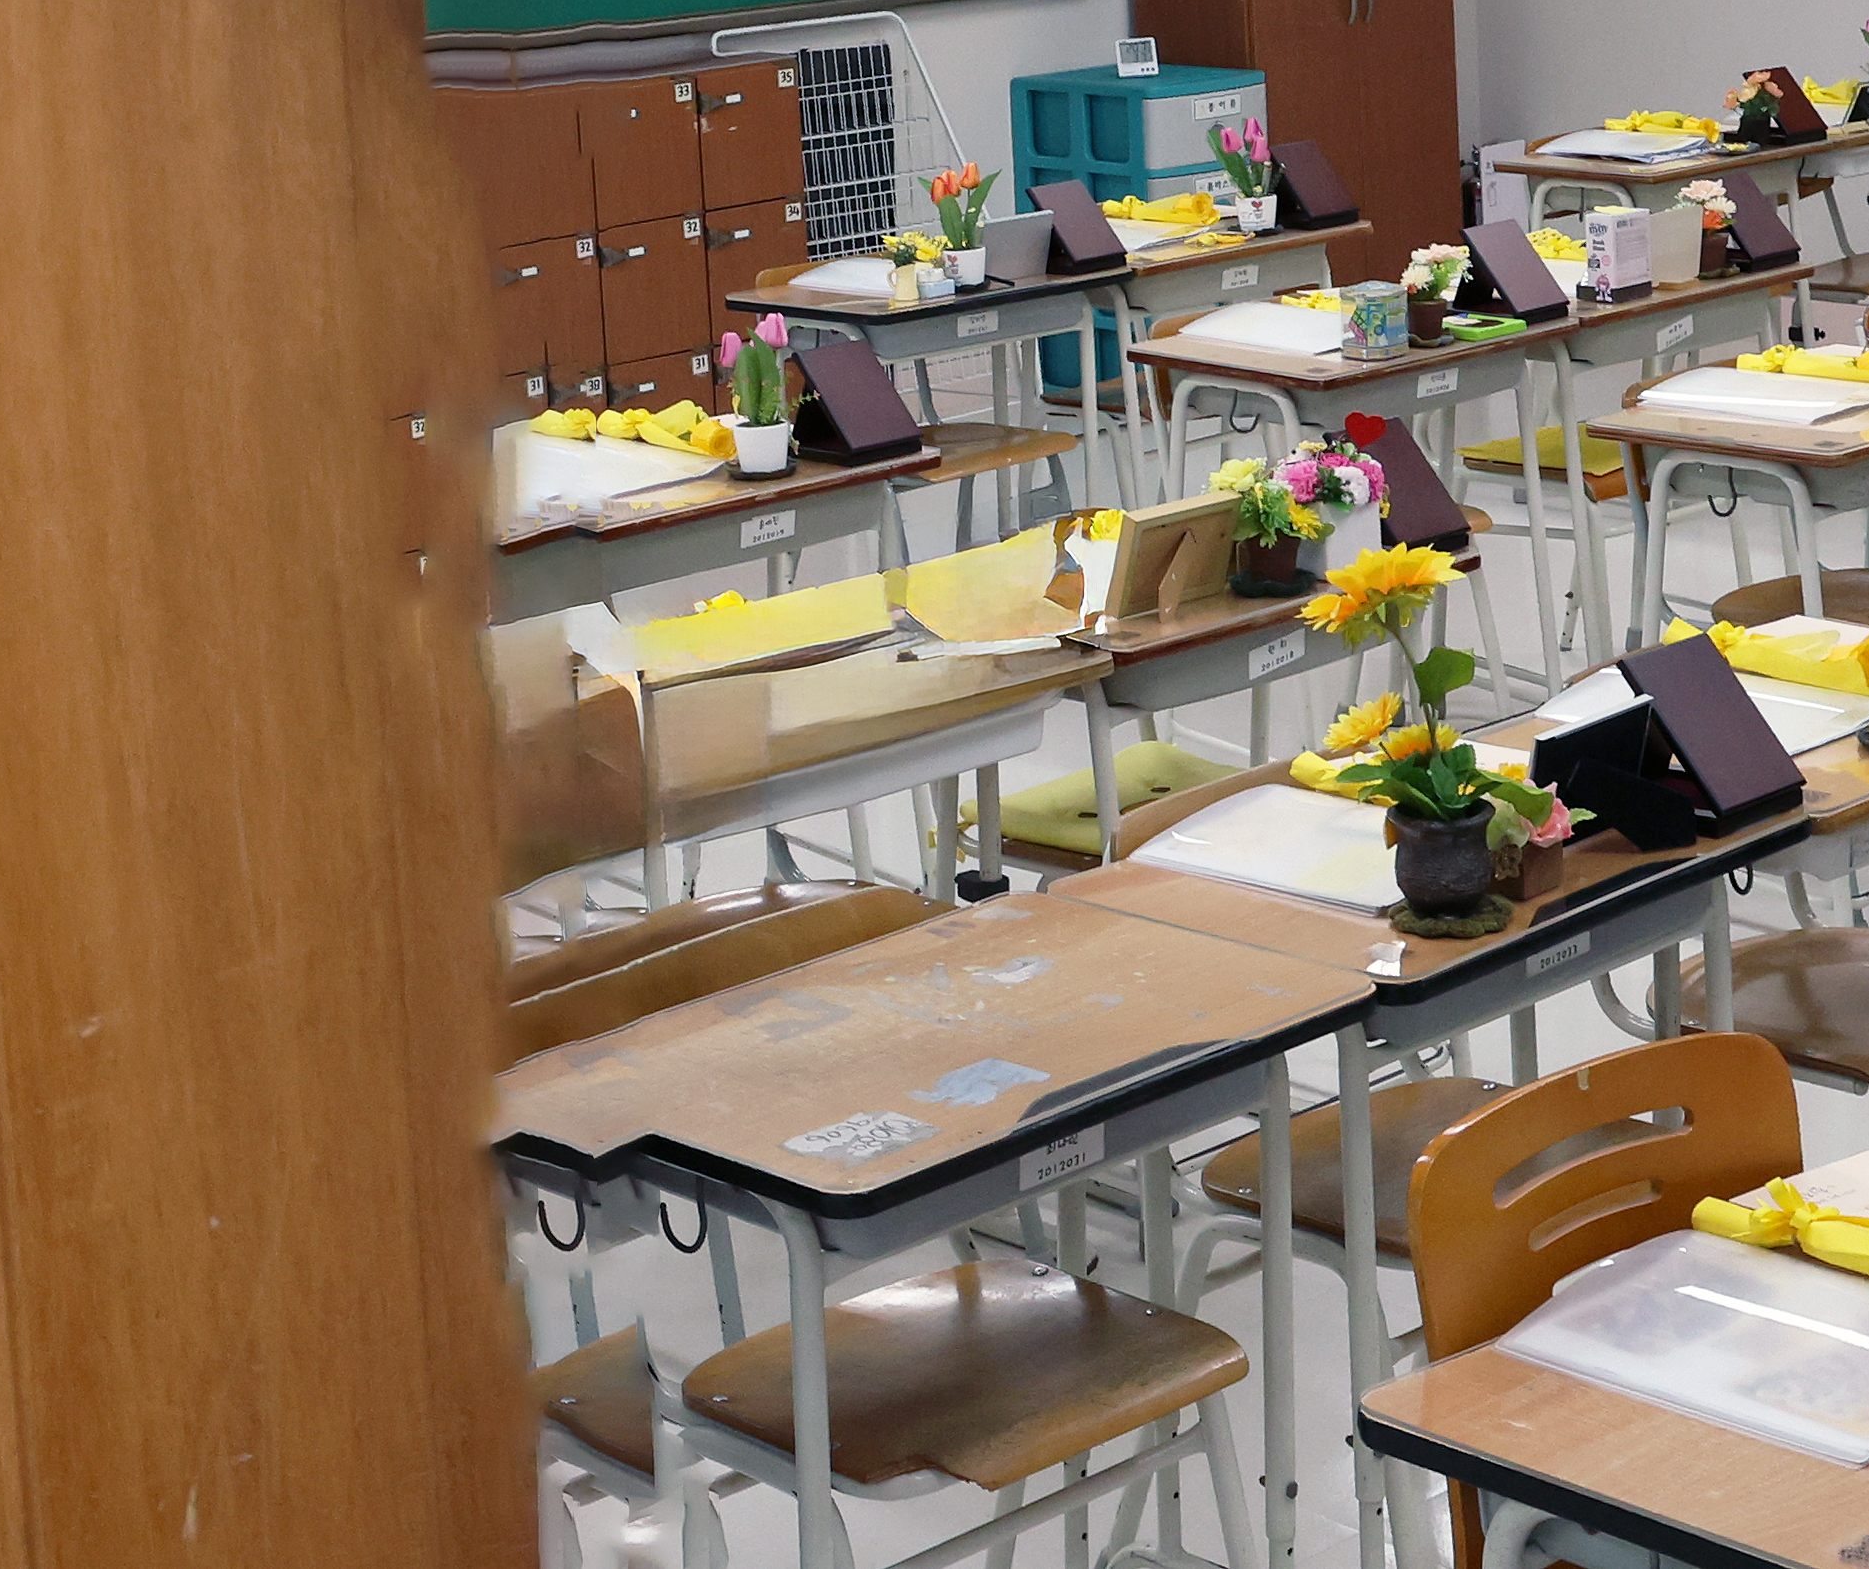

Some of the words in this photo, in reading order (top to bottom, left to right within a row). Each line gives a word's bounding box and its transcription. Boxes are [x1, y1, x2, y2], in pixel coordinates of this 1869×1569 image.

[779, 69, 794, 84] 35
[676, 84, 691, 99] 33
[786, 204, 801, 219] 34
[684, 220, 699, 234] 32
[577, 239, 593, 254] 32
[694, 357, 707, 371] 31
[529, 378, 541, 392] 31
[413, 421, 425, 433] 32
